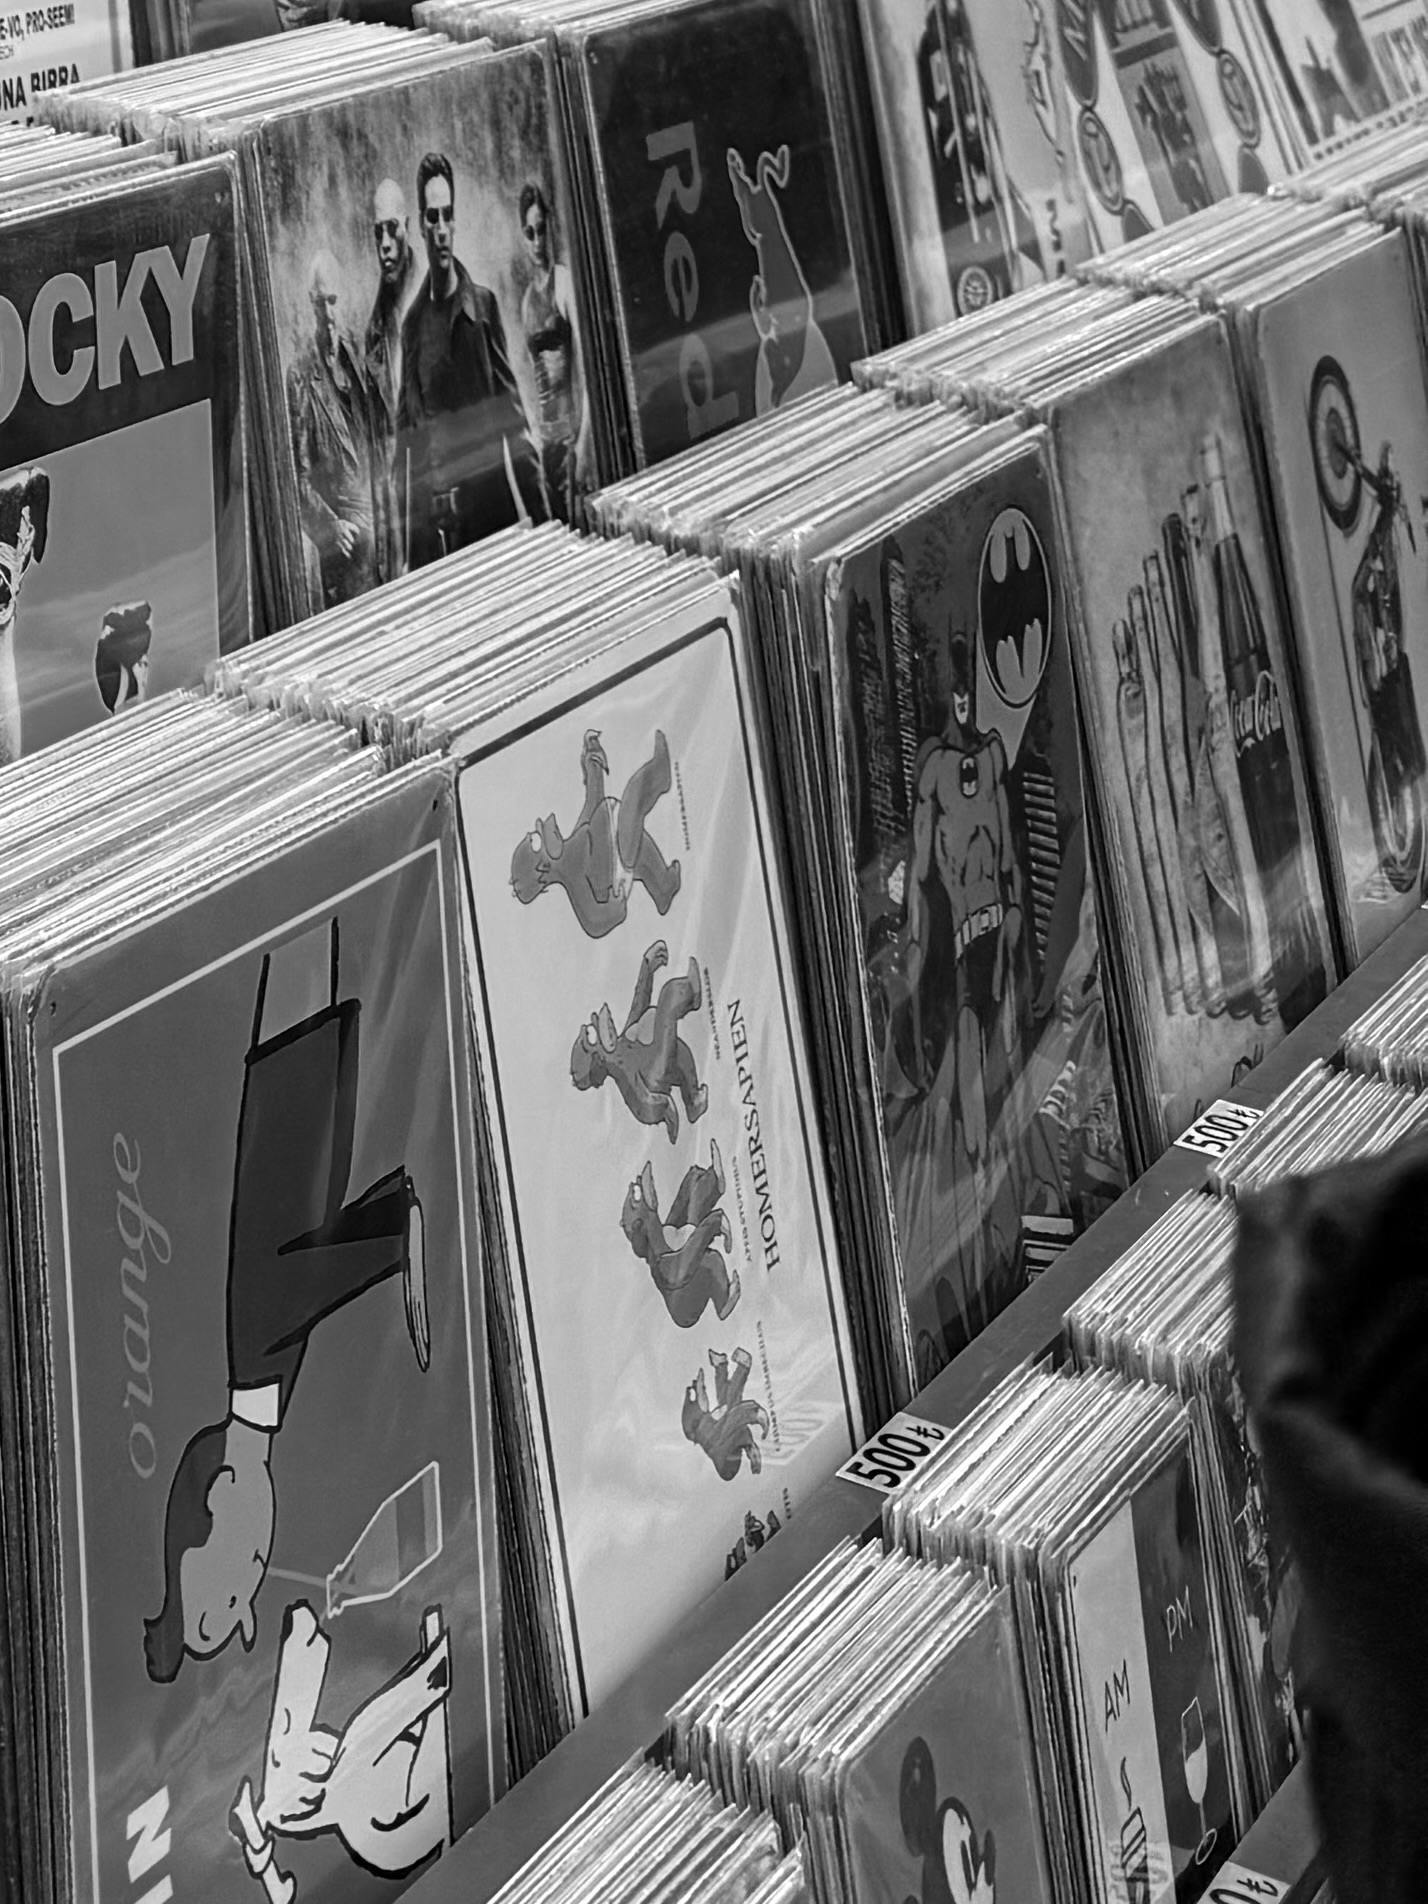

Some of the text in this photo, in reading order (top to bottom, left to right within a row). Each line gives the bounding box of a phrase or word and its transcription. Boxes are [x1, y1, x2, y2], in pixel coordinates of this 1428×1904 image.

[728, 997, 782, 1273] HOMERSAPIEN
[104, 1129, 174, 1482] orange
[1102, 1659, 1132, 1736] AM
[1163, 1586, 1195, 1654] PM
